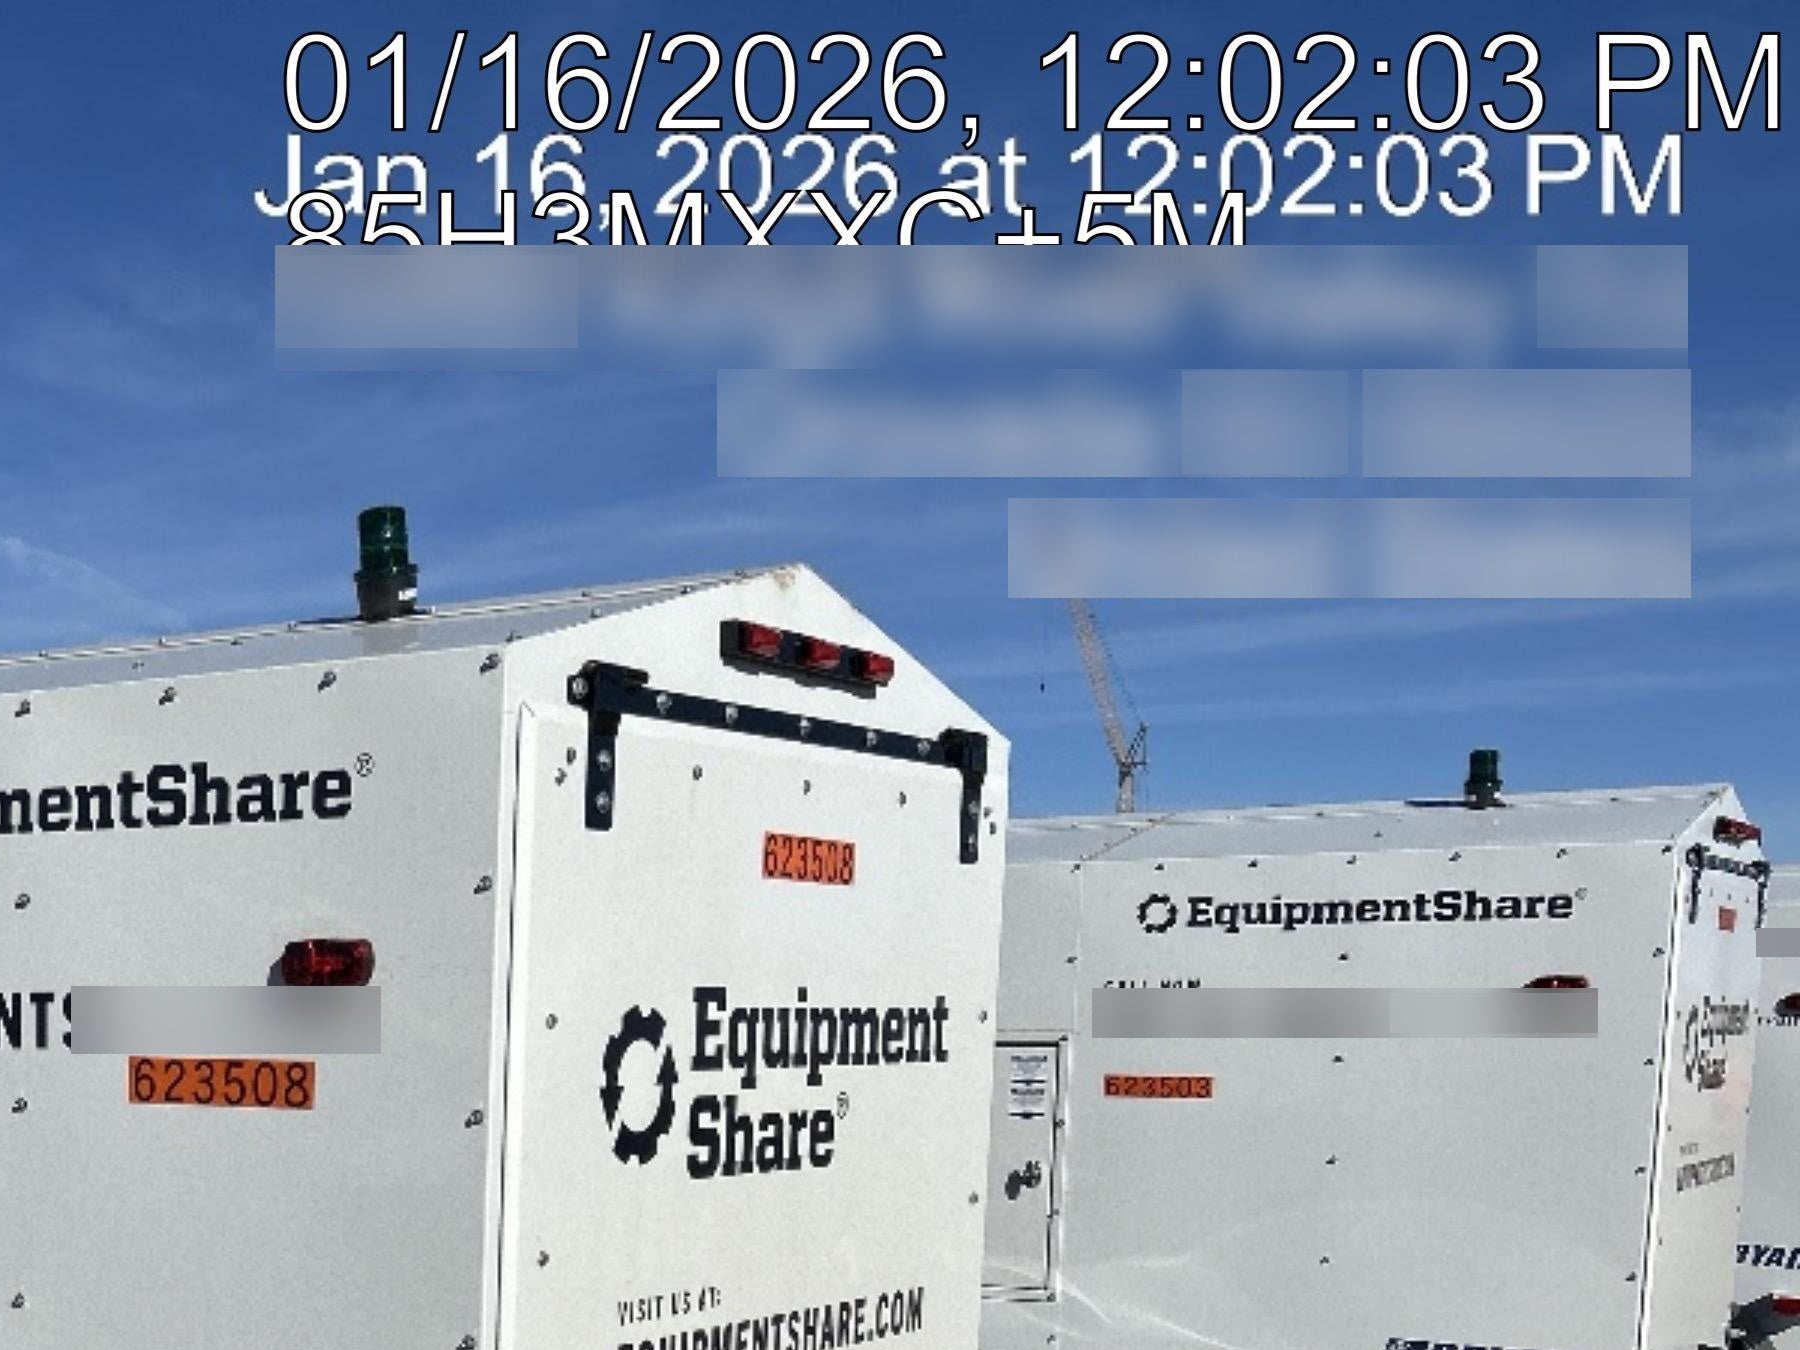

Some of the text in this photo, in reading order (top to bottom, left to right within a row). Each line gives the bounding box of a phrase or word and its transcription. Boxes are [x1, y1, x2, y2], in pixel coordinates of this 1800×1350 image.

[765, 833, 854, 885] 623508
[690, 986, 949, 1090] Equipment
[132, 1057, 312, 1108] 623508
[1106, 1077, 1211, 1097] 623503
[617, 1295, 664, 1327] VISIT
[671, 1291, 691, 1316] US
